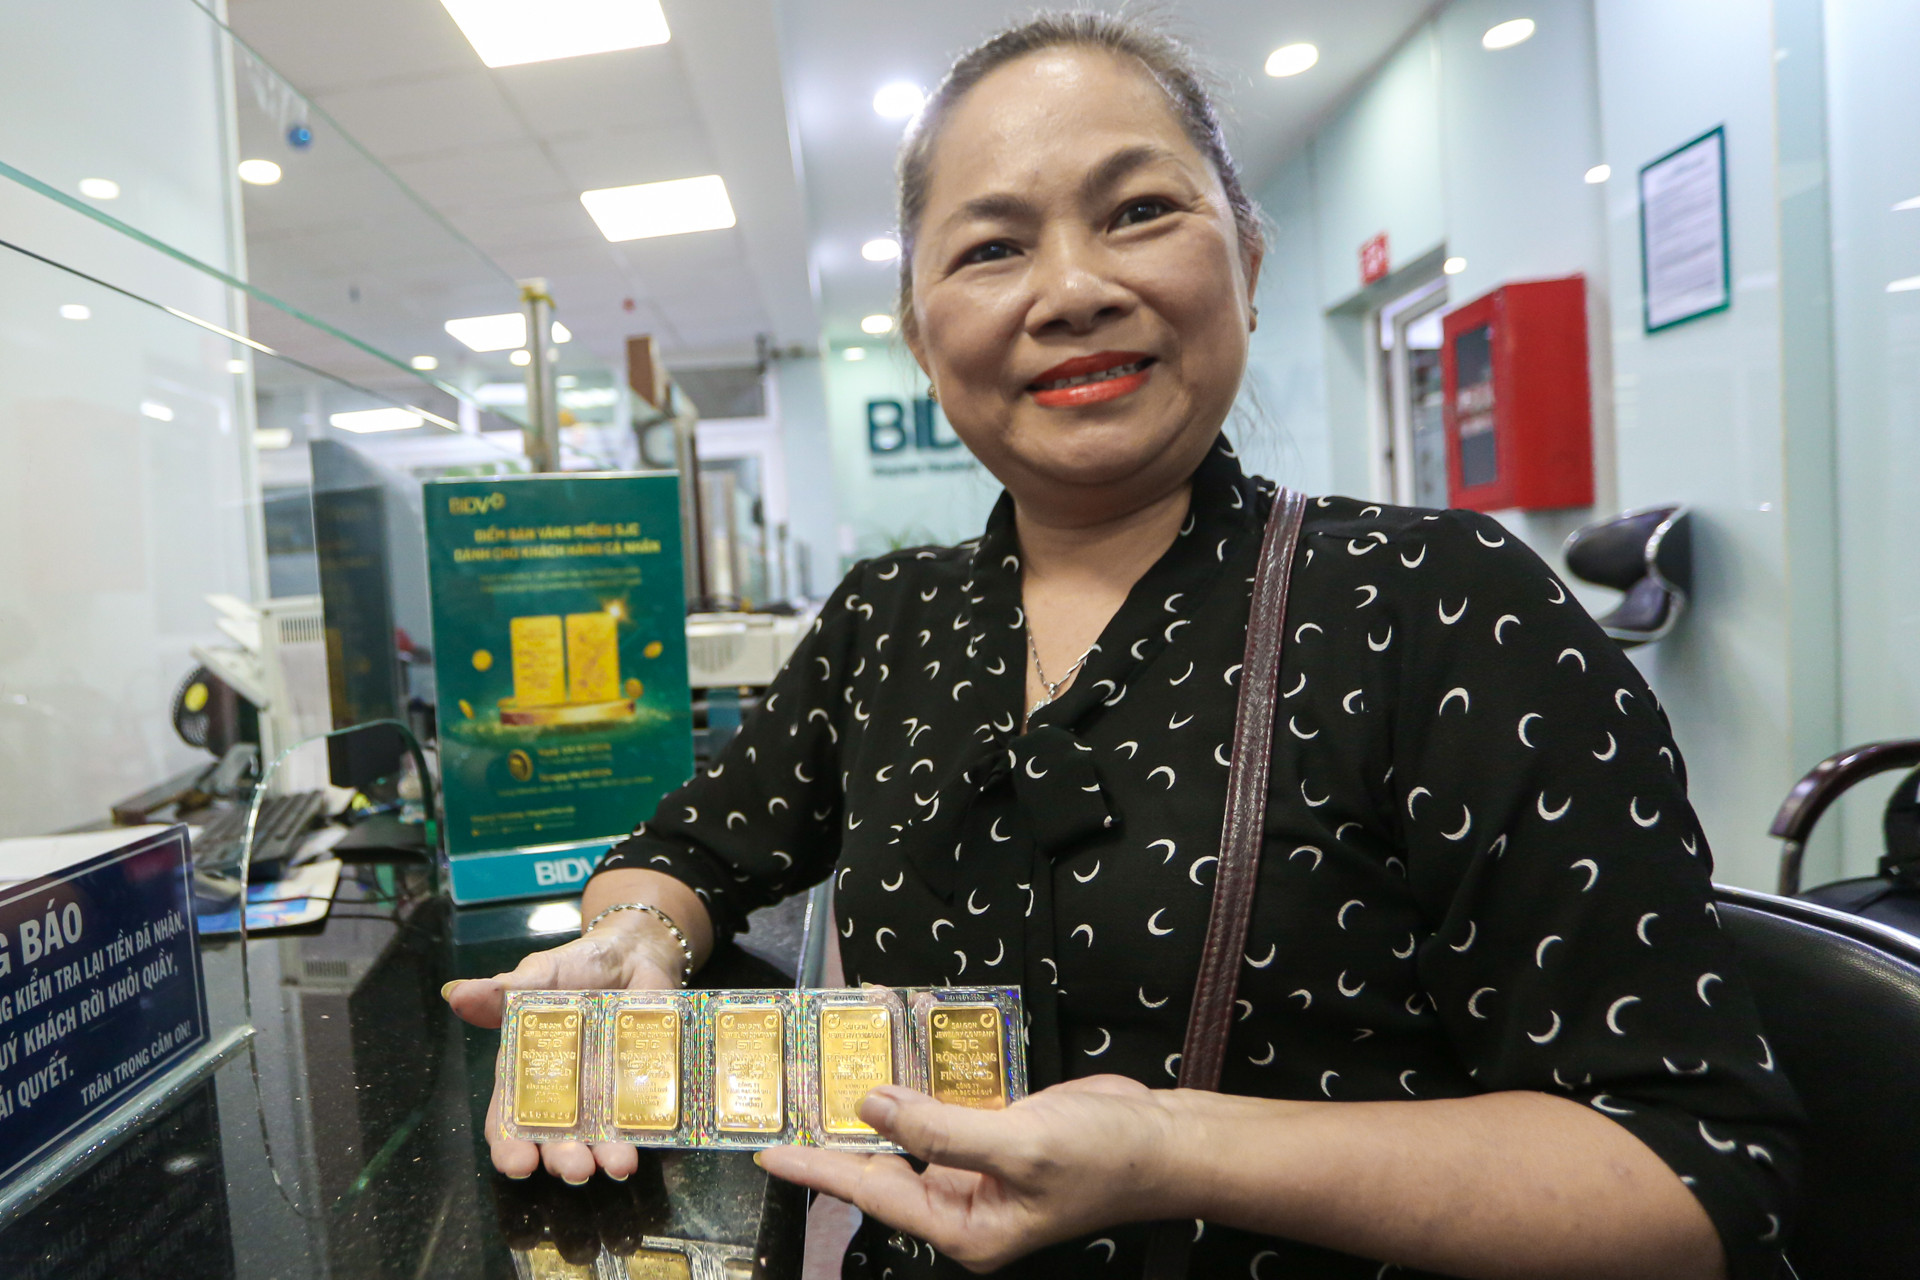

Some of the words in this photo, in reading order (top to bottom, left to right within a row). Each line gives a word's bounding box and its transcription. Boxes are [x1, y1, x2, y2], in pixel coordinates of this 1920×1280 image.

[449, 495, 490, 516] BIDV
[20, 898, 82, 966] BÁO
[15, 968, 52, 1014] KIỂM
[54, 961, 81, 993] TRA
[84, 949, 104, 979] LẠI
[106, 929, 134, 967] TIỀN
[135, 921, 152, 953] ĐÃ
[153, 909, 185, 944] NHẬN.
[24, 1006, 77, 1056] KHÁCH
[80, 989, 105, 1024] RỜI
[108, 966, 140, 1008] KHỎI
[142, 948, 178, 990] QUẦY,
[537, 1039, 563, 1049] SJC
[635, 1039, 660, 1051] SJC
[736, 1040, 762, 1052] SJC
[843, 1040, 870, 1052] SJC
[952, 1039, 979, 1052] SJC
[967, 1052, 997, 1062] VÀNG
[18, 1050, 74, 1108] QUYẾT.
[81, 1073, 112, 1106] TRÂN
[113, 1048, 150, 1084] TRỌNG
[966, 1070, 994, 1080] GOLD
